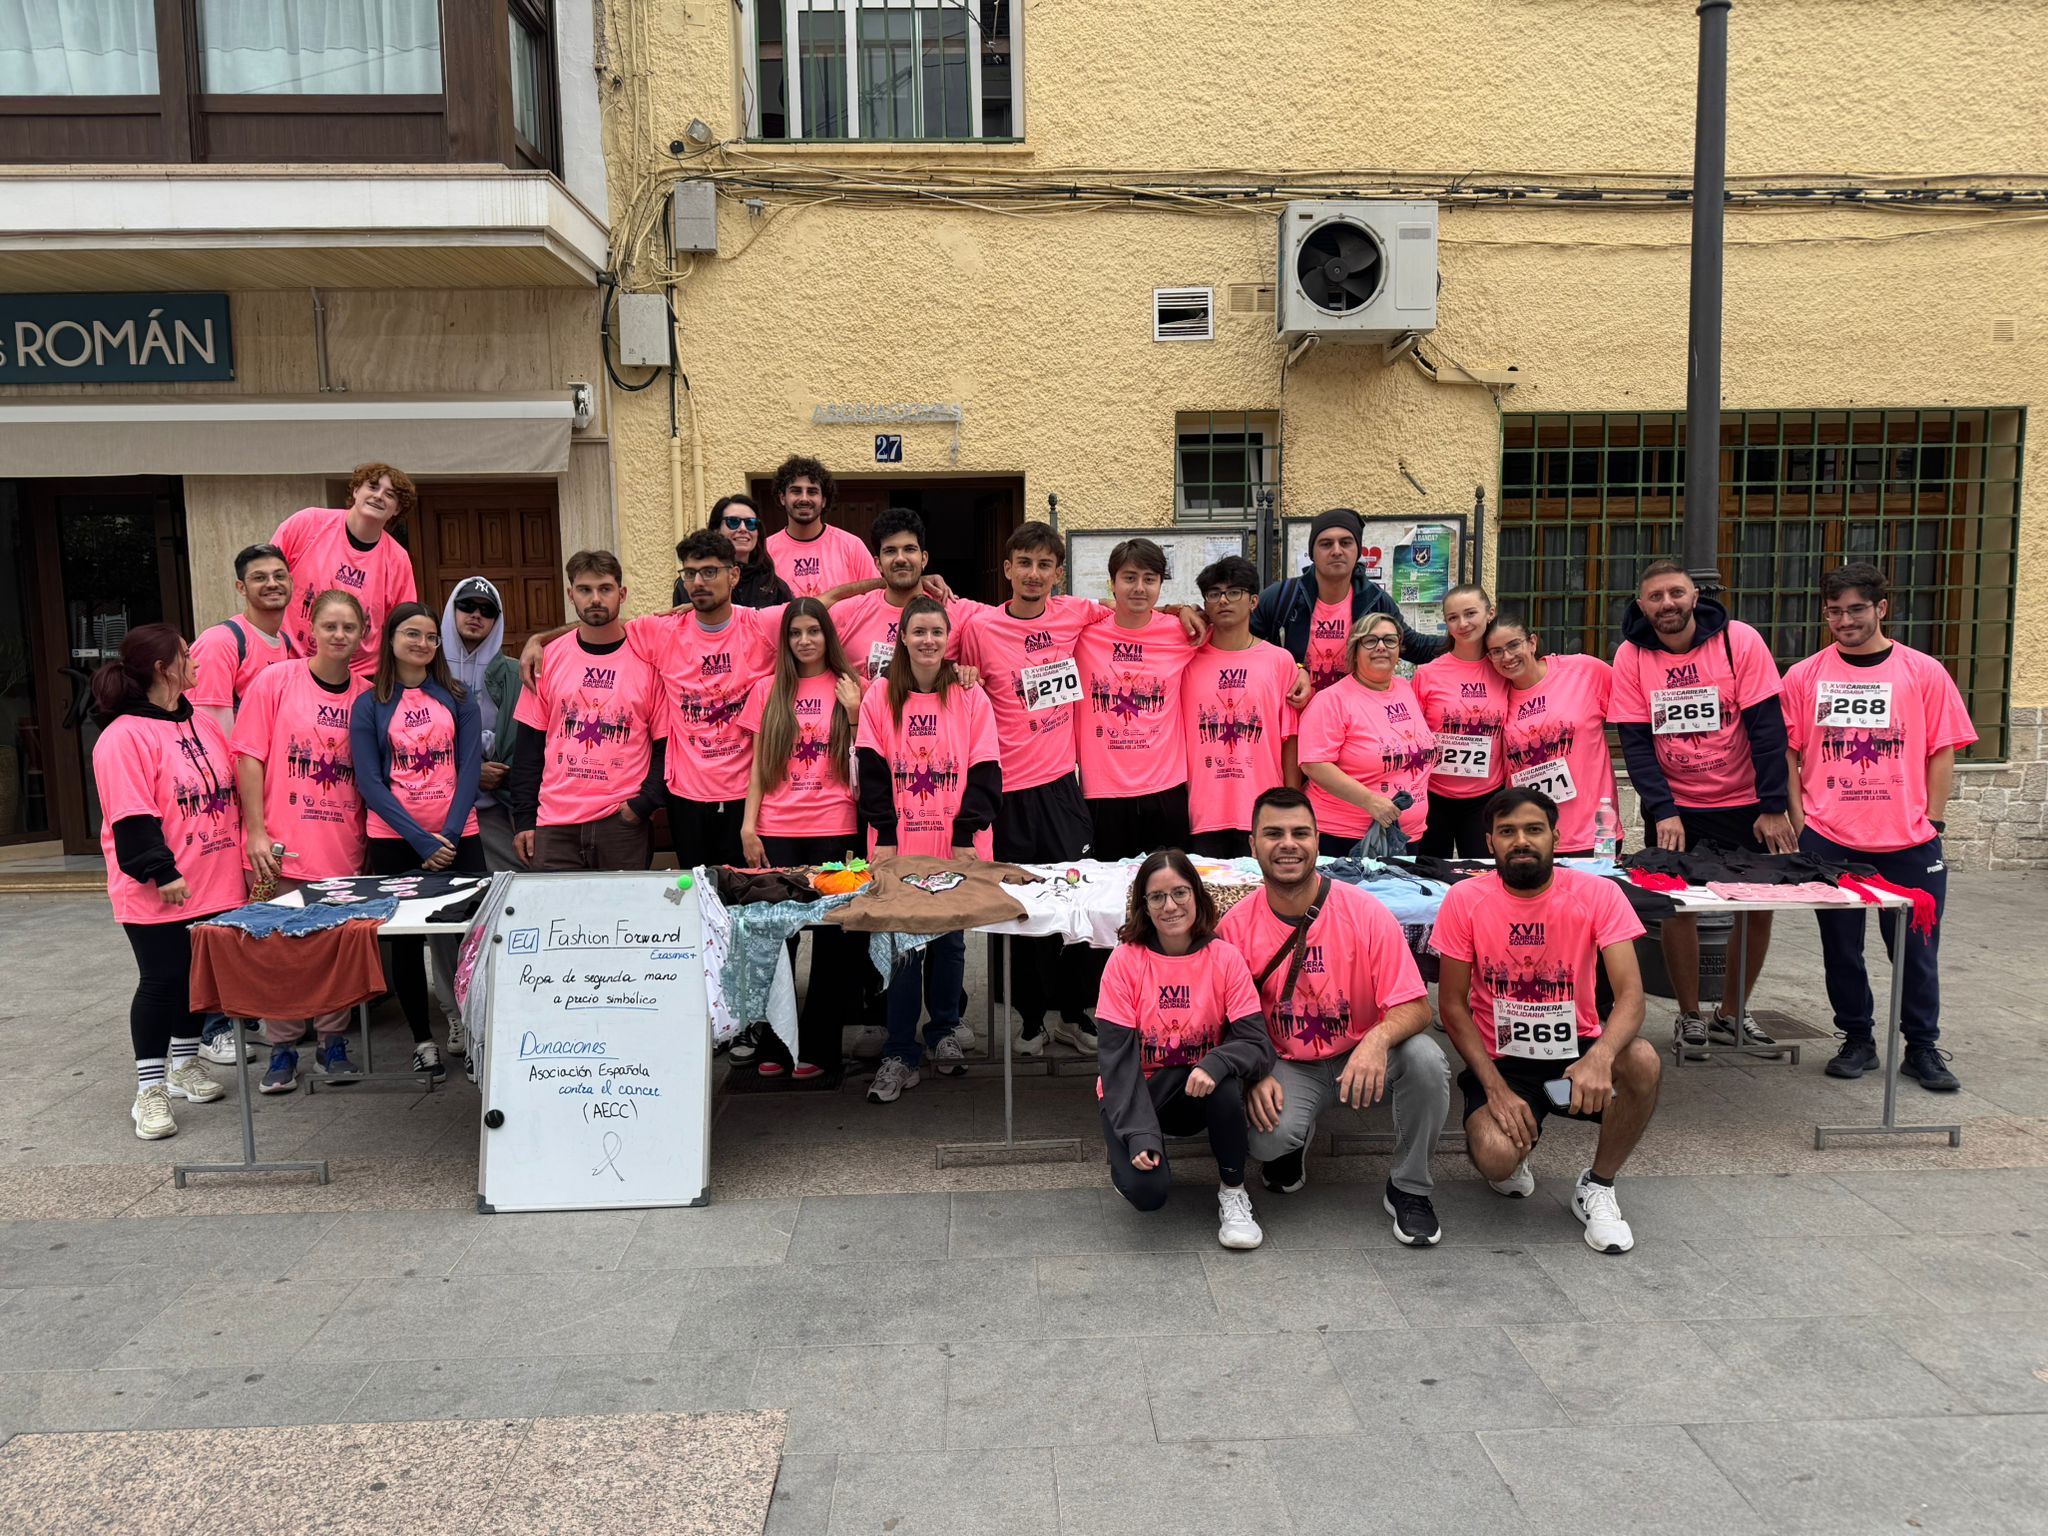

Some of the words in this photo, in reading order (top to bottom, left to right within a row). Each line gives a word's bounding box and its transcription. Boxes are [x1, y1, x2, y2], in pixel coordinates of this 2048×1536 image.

[15, 309, 216, 367] ROMÁN
[876, 436, 901, 460] 27
[794, 557, 819, 568] XVII
[339, 563, 366, 583] XVII
[1317, 620, 1344, 631] XVII
[1025, 631, 1052, 647] XVII
[1113, 643, 1143, 654] XVII
[702, 653, 731, 666] XVII
[585, 666, 616, 681] XVII
[1220, 669, 1248, 680] XVII
[1666, 663, 1697, 680] XVII
[1038, 674, 1077, 696] 270
[1461, 683, 1486, 692] XVII
[796, 699, 821, 708] XVII
[1384, 703, 1408, 716] XVII
[1519, 696, 1545, 711] XVII
[1668, 702, 1715, 720] 265
[1833, 698, 1886, 715] 268
[318, 704, 348, 720] XVII
[405, 708, 430, 721] XVII
[909, 715, 937, 726] XVII
[1444, 749, 1487, 765] 272
[1926, 864, 1944, 874] PUMA
[511, 932, 537, 950] EU
[549, 918, 610, 947] Fashion
[616, 919, 681, 946] Forward
[1509, 923, 1545, 936] XVII
[519, 964, 555, 993] Ropa
[562, 968, 576, 983] de
[584, 970, 637, 990] segunda
[644, 971, 678, 981] mano
[1159, 986, 1190, 998] XVII
[553, 995, 562, 1004] a
[565, 995, 600, 1010] precio
[606, 991, 658, 1005] simbólico
[1506, 1009, 1545, 1018] SOLIDARIA
[1513, 1022, 1572, 1043] 269
[519, 1031, 607, 1058] Donaciones
[529, 1064, 592, 1082] Asociación
[598, 1063, 650, 1079] Española
[558, 1083, 595, 1095] contra
[601, 1079, 612, 1096] el
[583, 1099, 639, 1124] (AECC)
